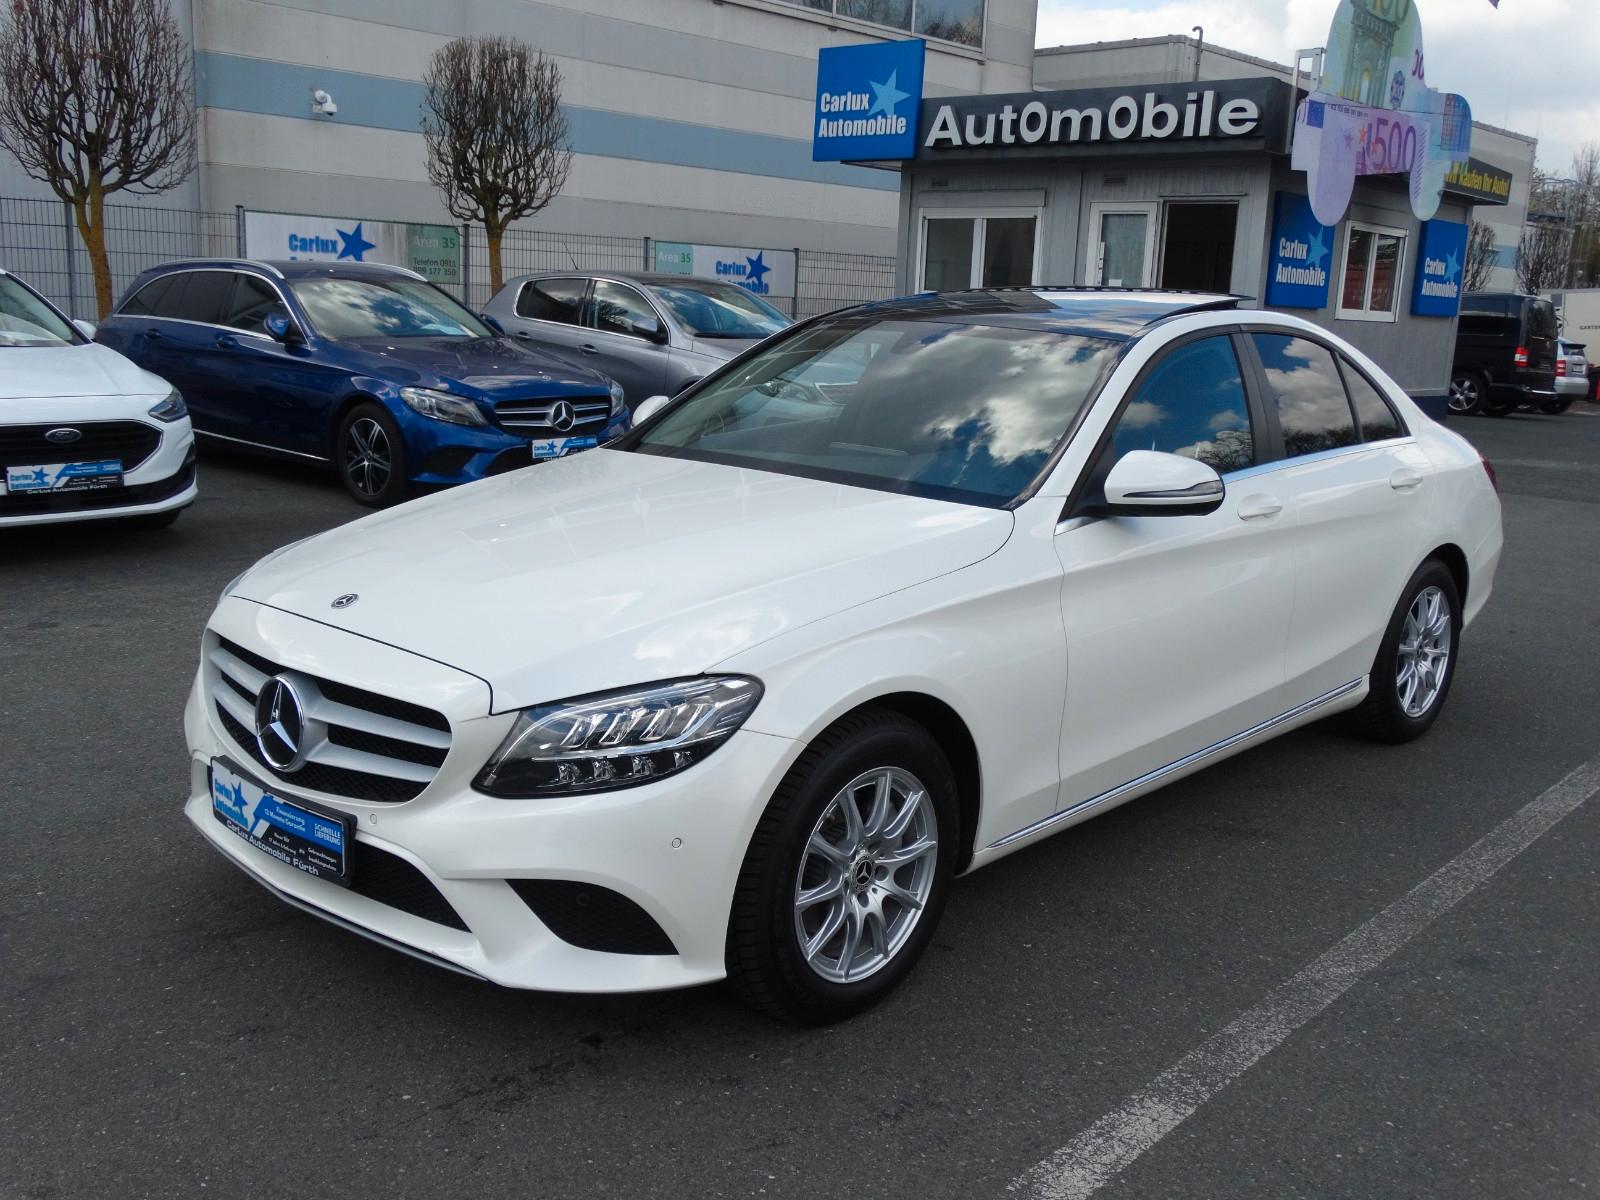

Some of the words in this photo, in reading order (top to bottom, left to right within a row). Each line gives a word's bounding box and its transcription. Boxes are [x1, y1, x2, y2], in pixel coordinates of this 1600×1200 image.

[820, 91, 870, 113] Carlux
[818, 115, 907, 138] Automobile
[288, 233, 338, 254] Carlux
[442, 236, 456, 249] 35
[1279, 237, 1307, 260] Carlux
[413, 257, 439, 267] Telefon
[658, 252, 679, 264] Area
[680, 252, 691, 264] 35
[1424, 257, 1446, 276] Carlux
[716, 260, 747, 276] Carlux
[1276, 263, 1326, 287] Automobile
[1421, 279, 1458, 298] Automobile
[314, 823, 341, 839] SCHNELLE
[314, 829, 341, 846] LIEFERUNG
[249, 834, 291, 864] Automobile
